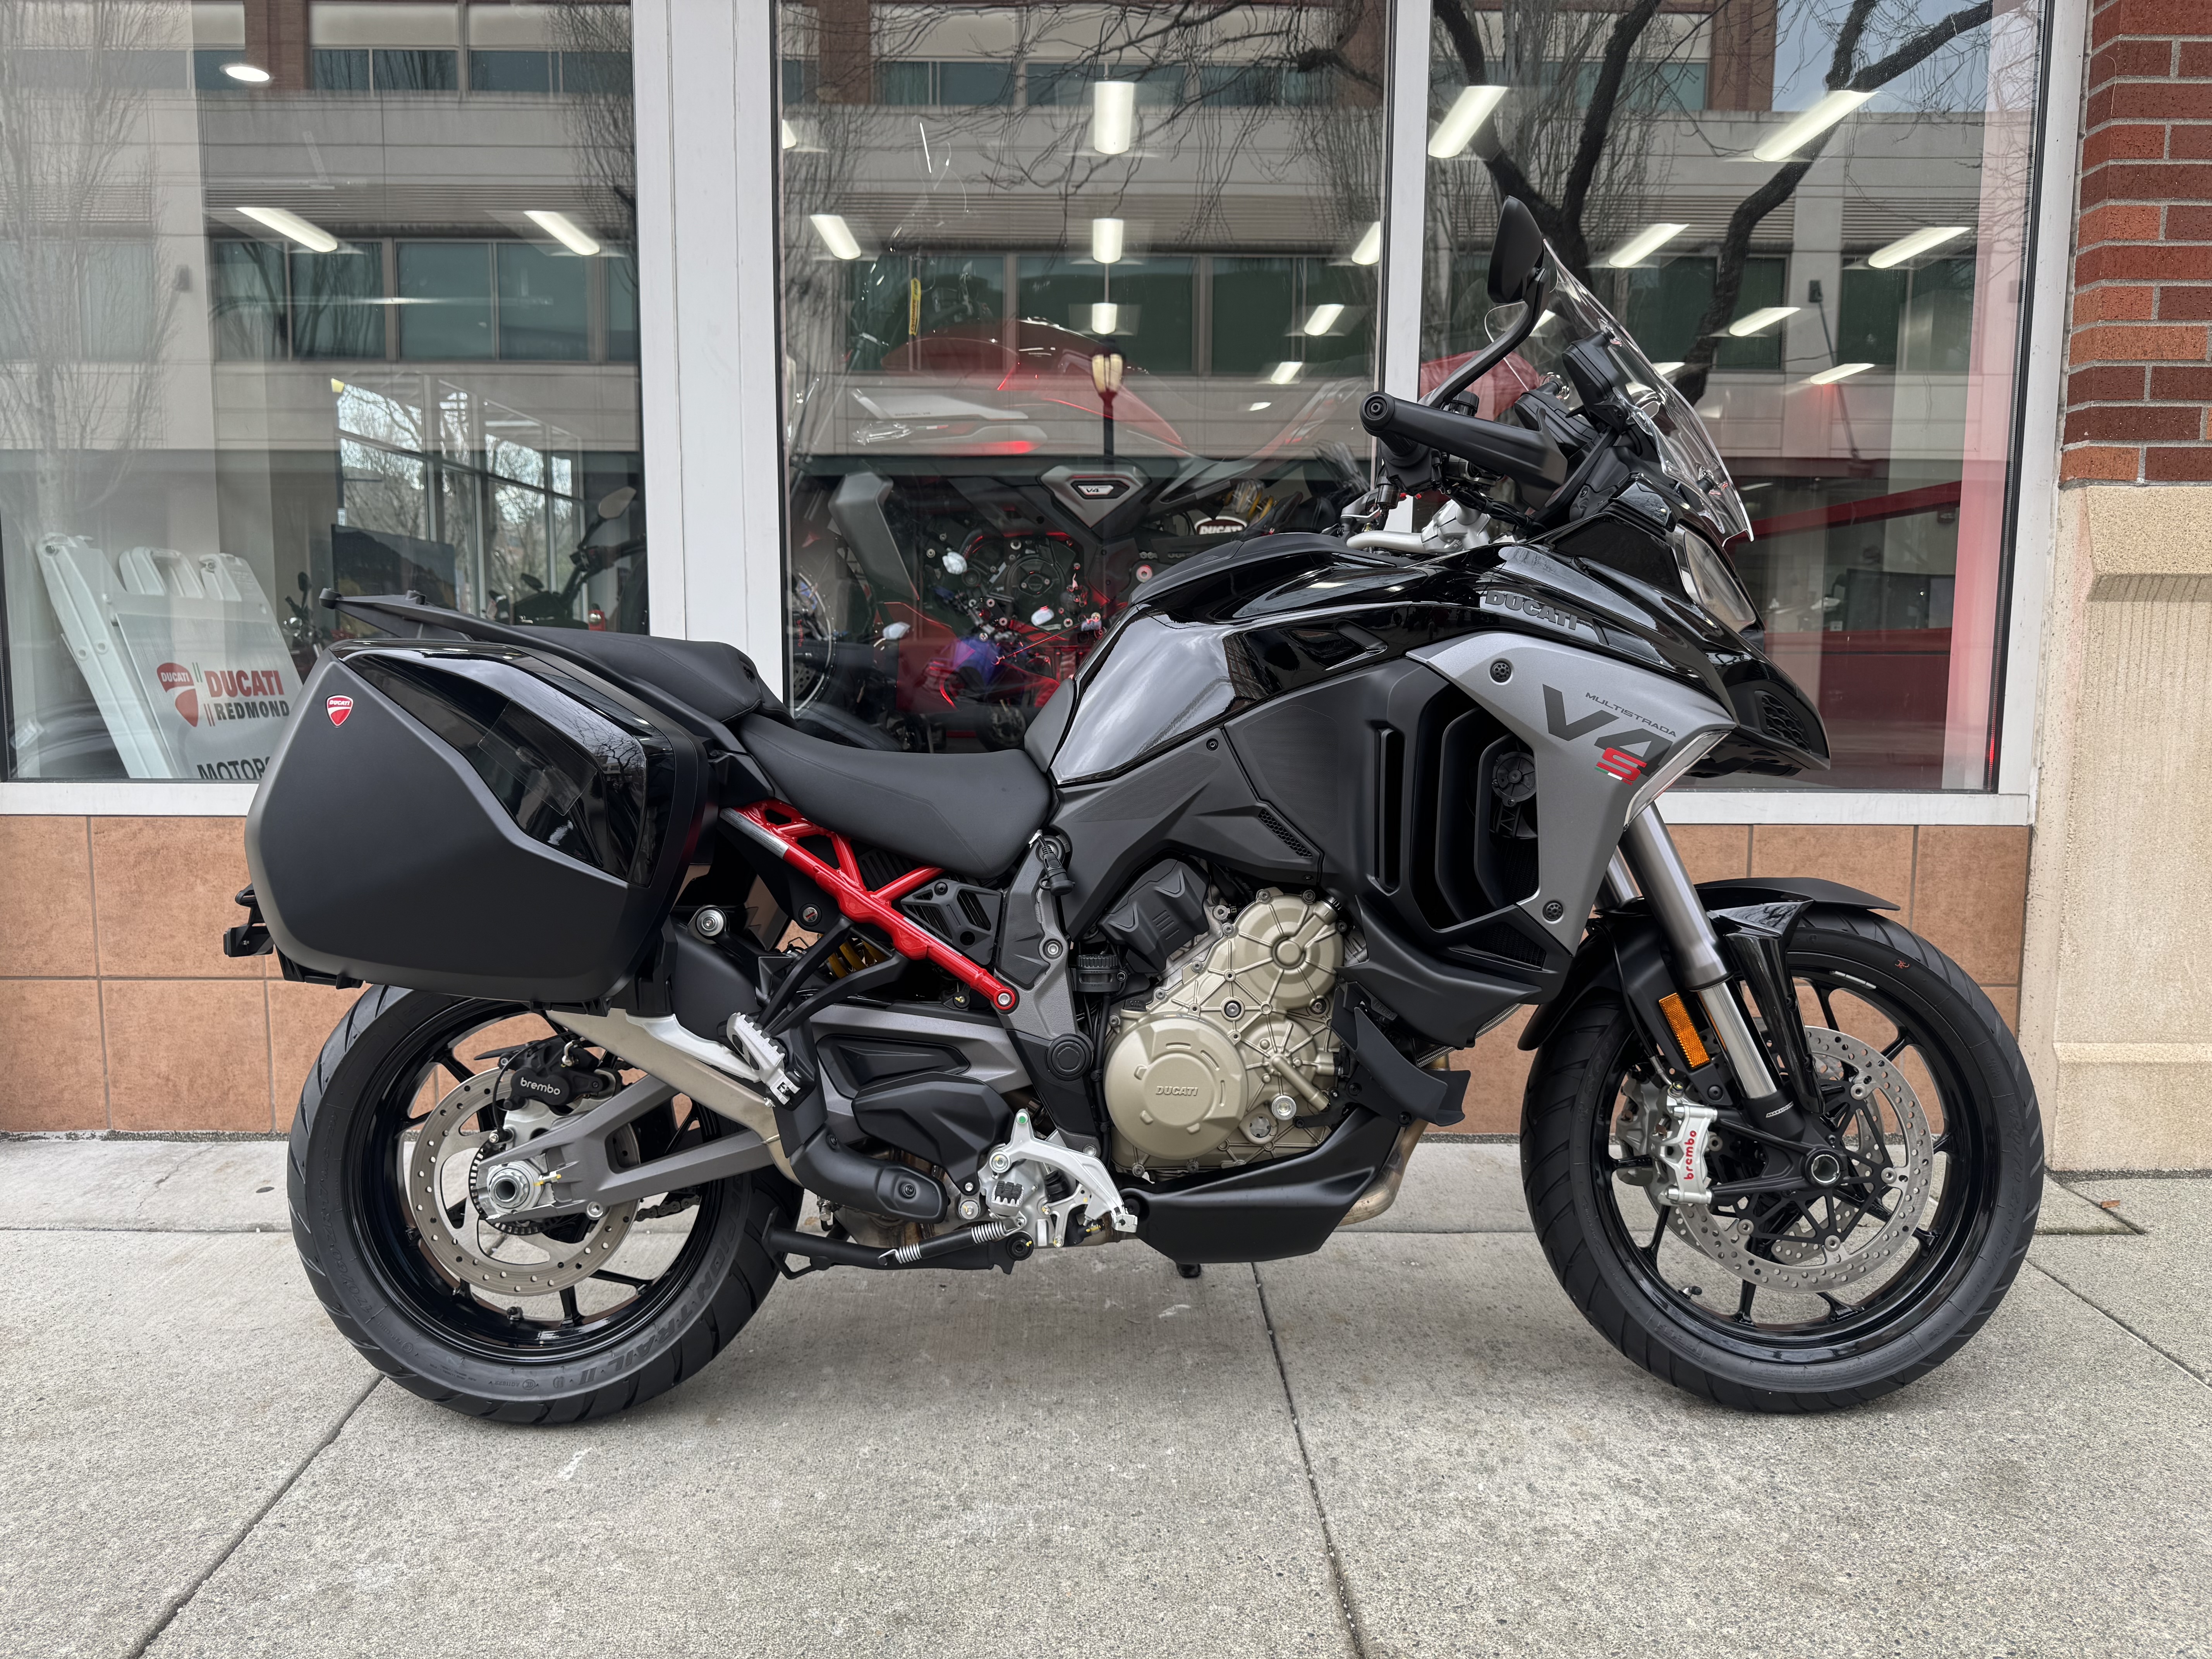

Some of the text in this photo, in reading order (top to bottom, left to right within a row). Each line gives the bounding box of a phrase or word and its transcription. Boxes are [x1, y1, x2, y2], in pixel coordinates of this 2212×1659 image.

[1485, 591, 1578, 630] DUCATI
[160, 672, 190, 682] DUCATI
[204, 670, 285, 697] DUCATI
[214, 701, 290, 721] REDMOND
[1585, 692, 1676, 737] MULTISTRADA
[1542, 684, 1673, 777] V4
[520, 1077, 560, 1095] brembo
[1156, 1086, 1198, 1096] DUCATI
[1684, 1130, 1696, 1180] brembo
[607, 1304, 693, 1372] TRAIL
[576, 1366, 601, 1384] II
